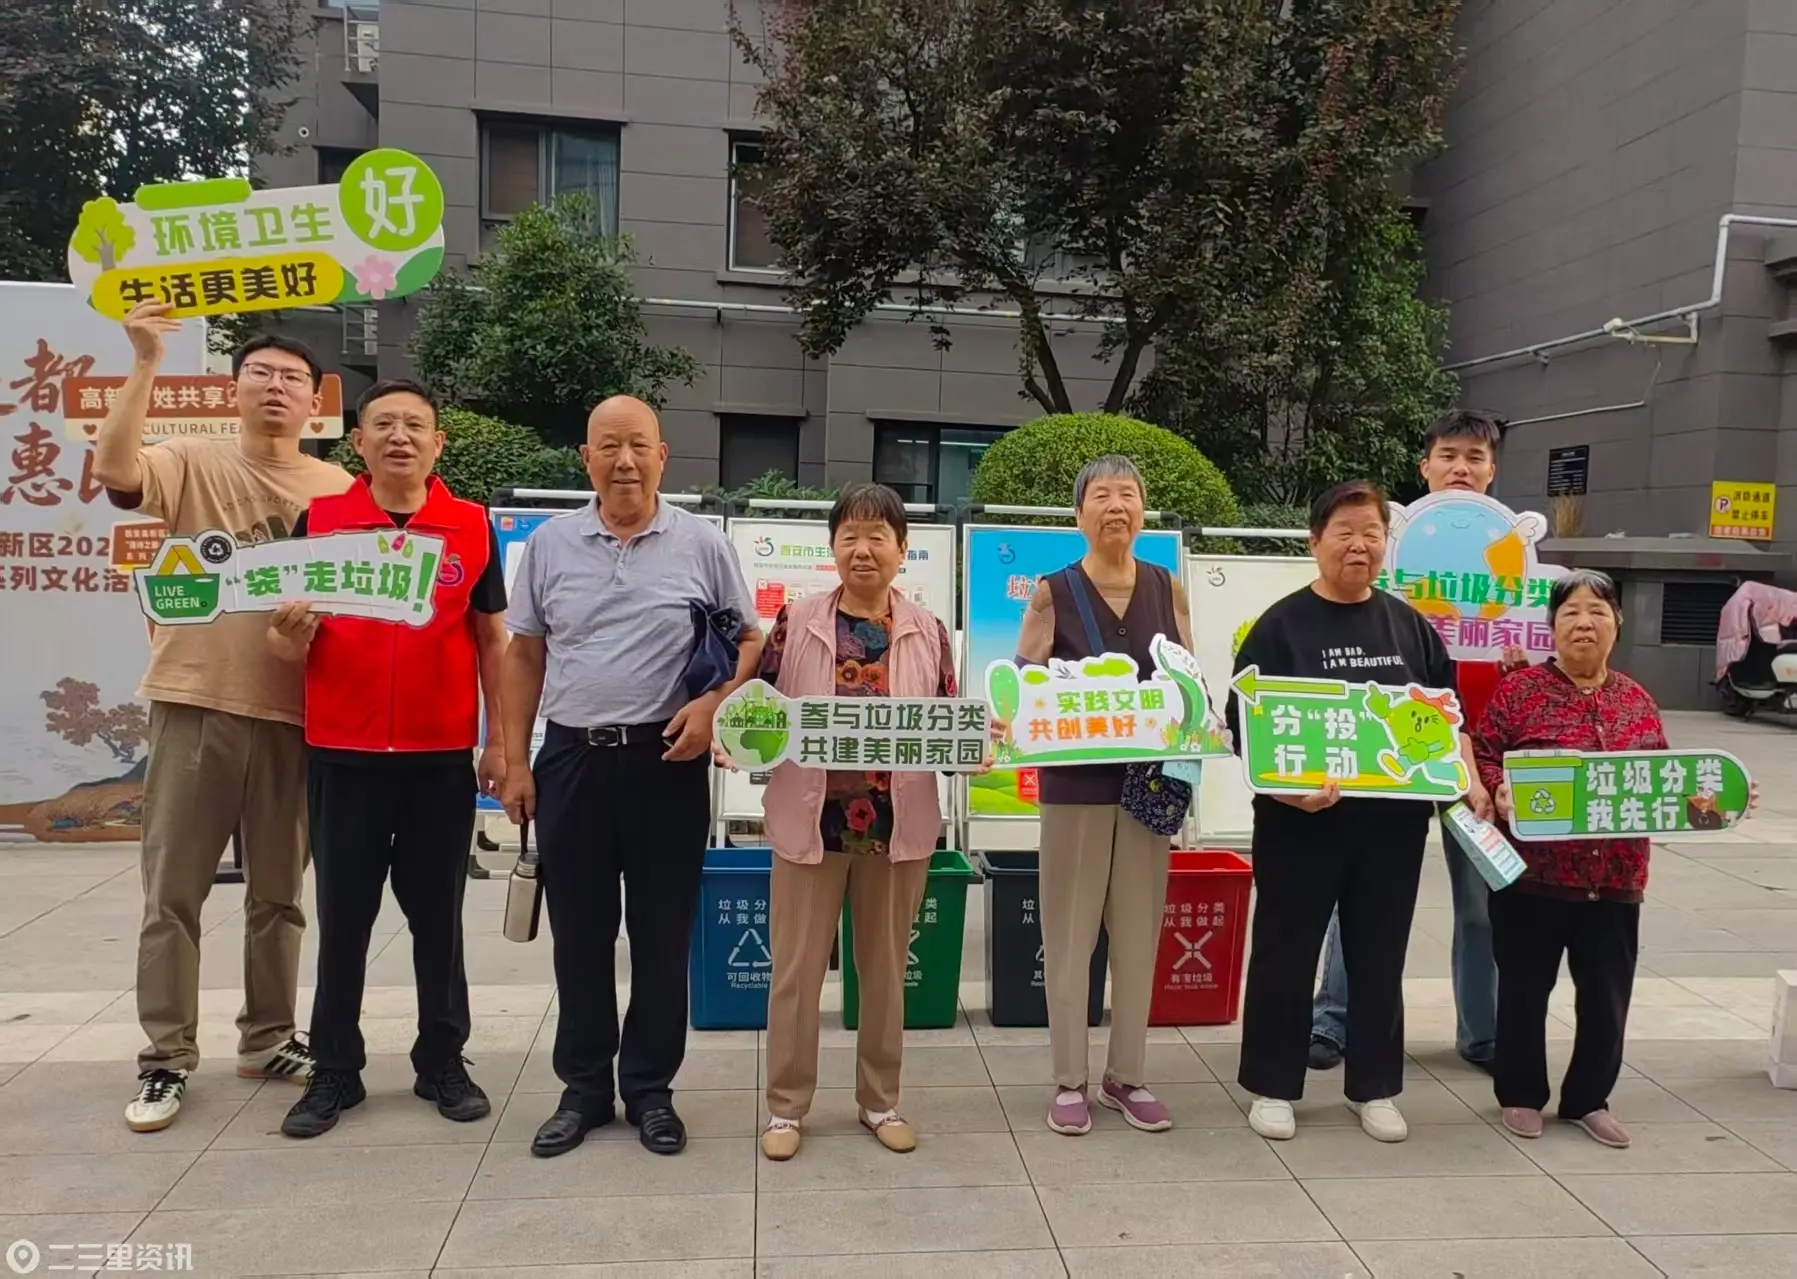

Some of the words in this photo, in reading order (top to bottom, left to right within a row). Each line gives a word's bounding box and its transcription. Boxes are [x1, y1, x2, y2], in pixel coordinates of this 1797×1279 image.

[359, 166, 424, 239] 好
[149, 202, 335, 257] 环境卫生
[119, 261, 318, 311] 生活更美好
[0, 338, 96, 415] 都
[143, 423, 216, 435] CULTURAL
[154, 585, 185, 597] LIVE
[156, 597, 200, 610] GREEN
[1328, 648, 1342, 657] AM
[1349, 655, 1404, 668] BEAUTIFUL
[1056, 688, 1165, 714] 实践文明
[801, 702, 985, 731] 参与垃圾分类
[1029, 714, 1137, 742] 共创美好
[800, 736, 984, 765] 共建美丽家园
[1274, 744, 1359, 779] 行动
[1586, 758, 1724, 796] 垃圾分类
[1586, 797, 1680, 832] 我先行
[718, 899, 768, 911] 垃圾分
[1022, 899, 1036, 910] 垃
[1164, 902, 1225, 914] 垃圾分类
[718, 912, 768, 925] 从我做
[1022, 913, 1035, 924] 从
[1164, 915, 1225, 928] 从我做起
